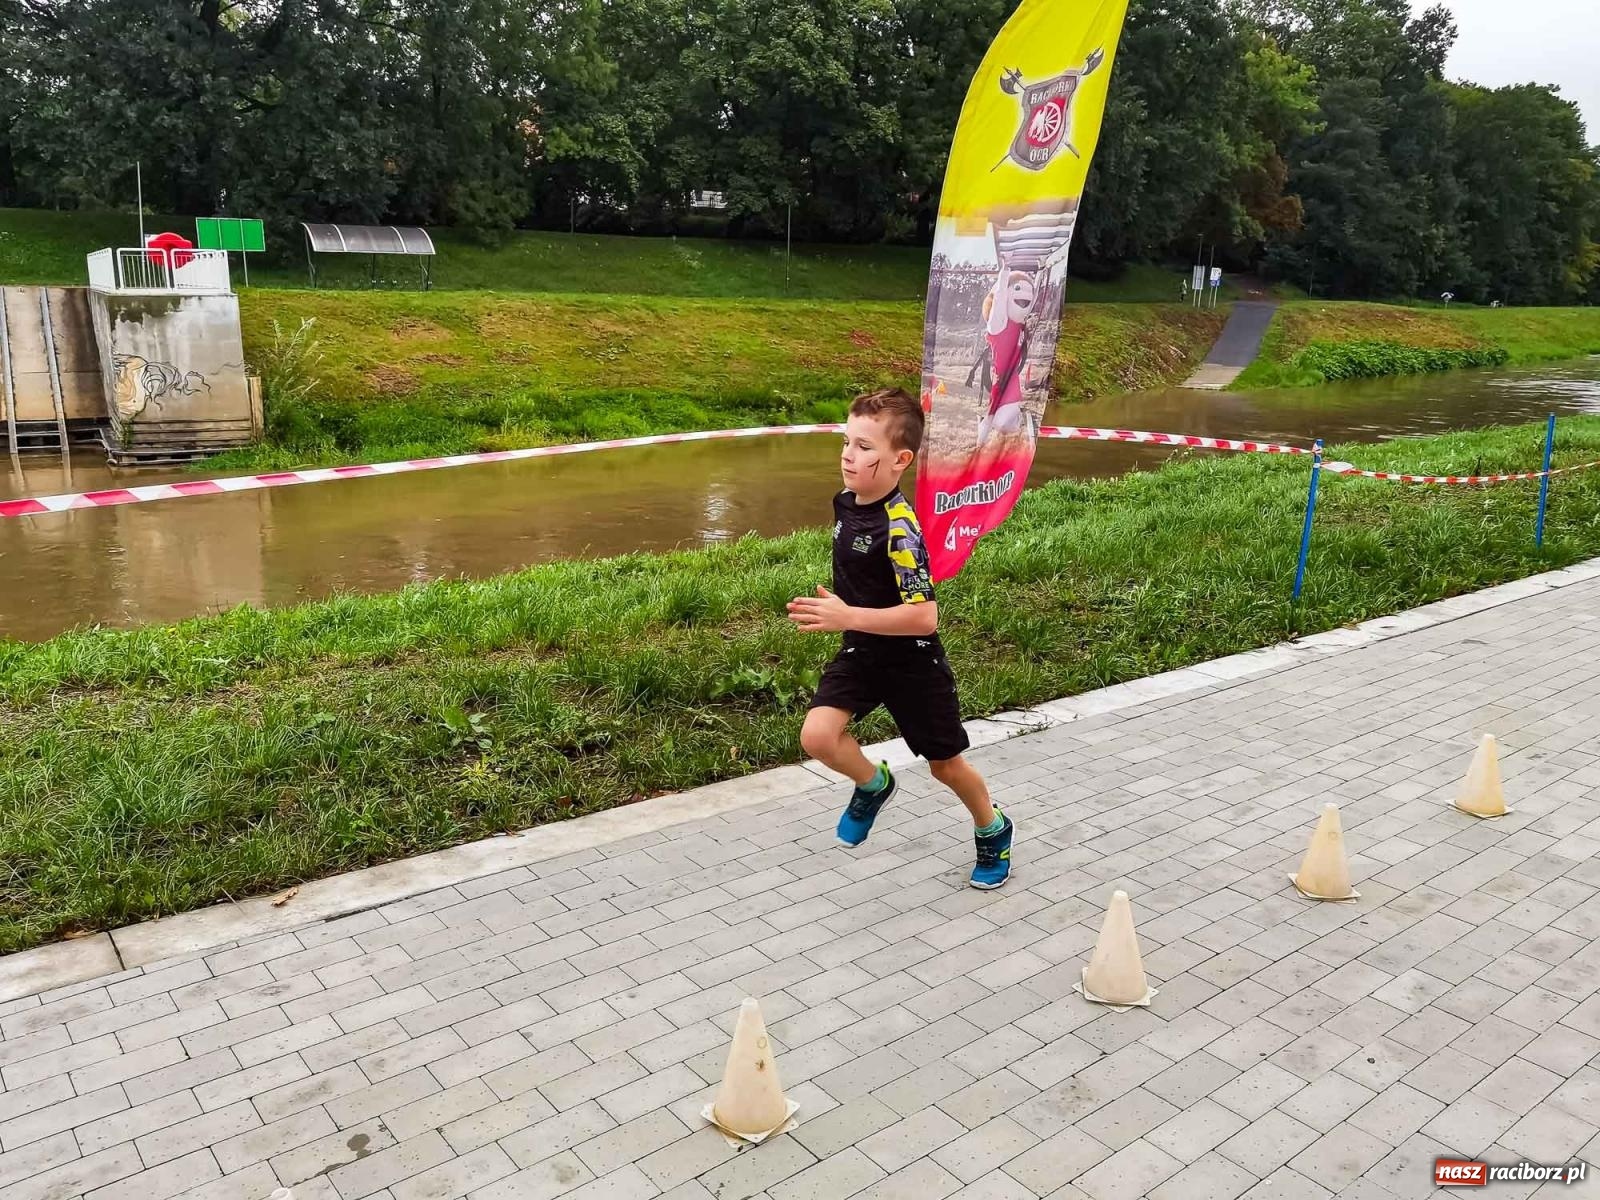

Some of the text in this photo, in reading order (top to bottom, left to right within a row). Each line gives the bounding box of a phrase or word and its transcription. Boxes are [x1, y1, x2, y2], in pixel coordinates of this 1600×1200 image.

[1029, 147, 1050, 162] OCR
[959, 524, 981, 537] Me
[908, 581, 930, 591] MORE
